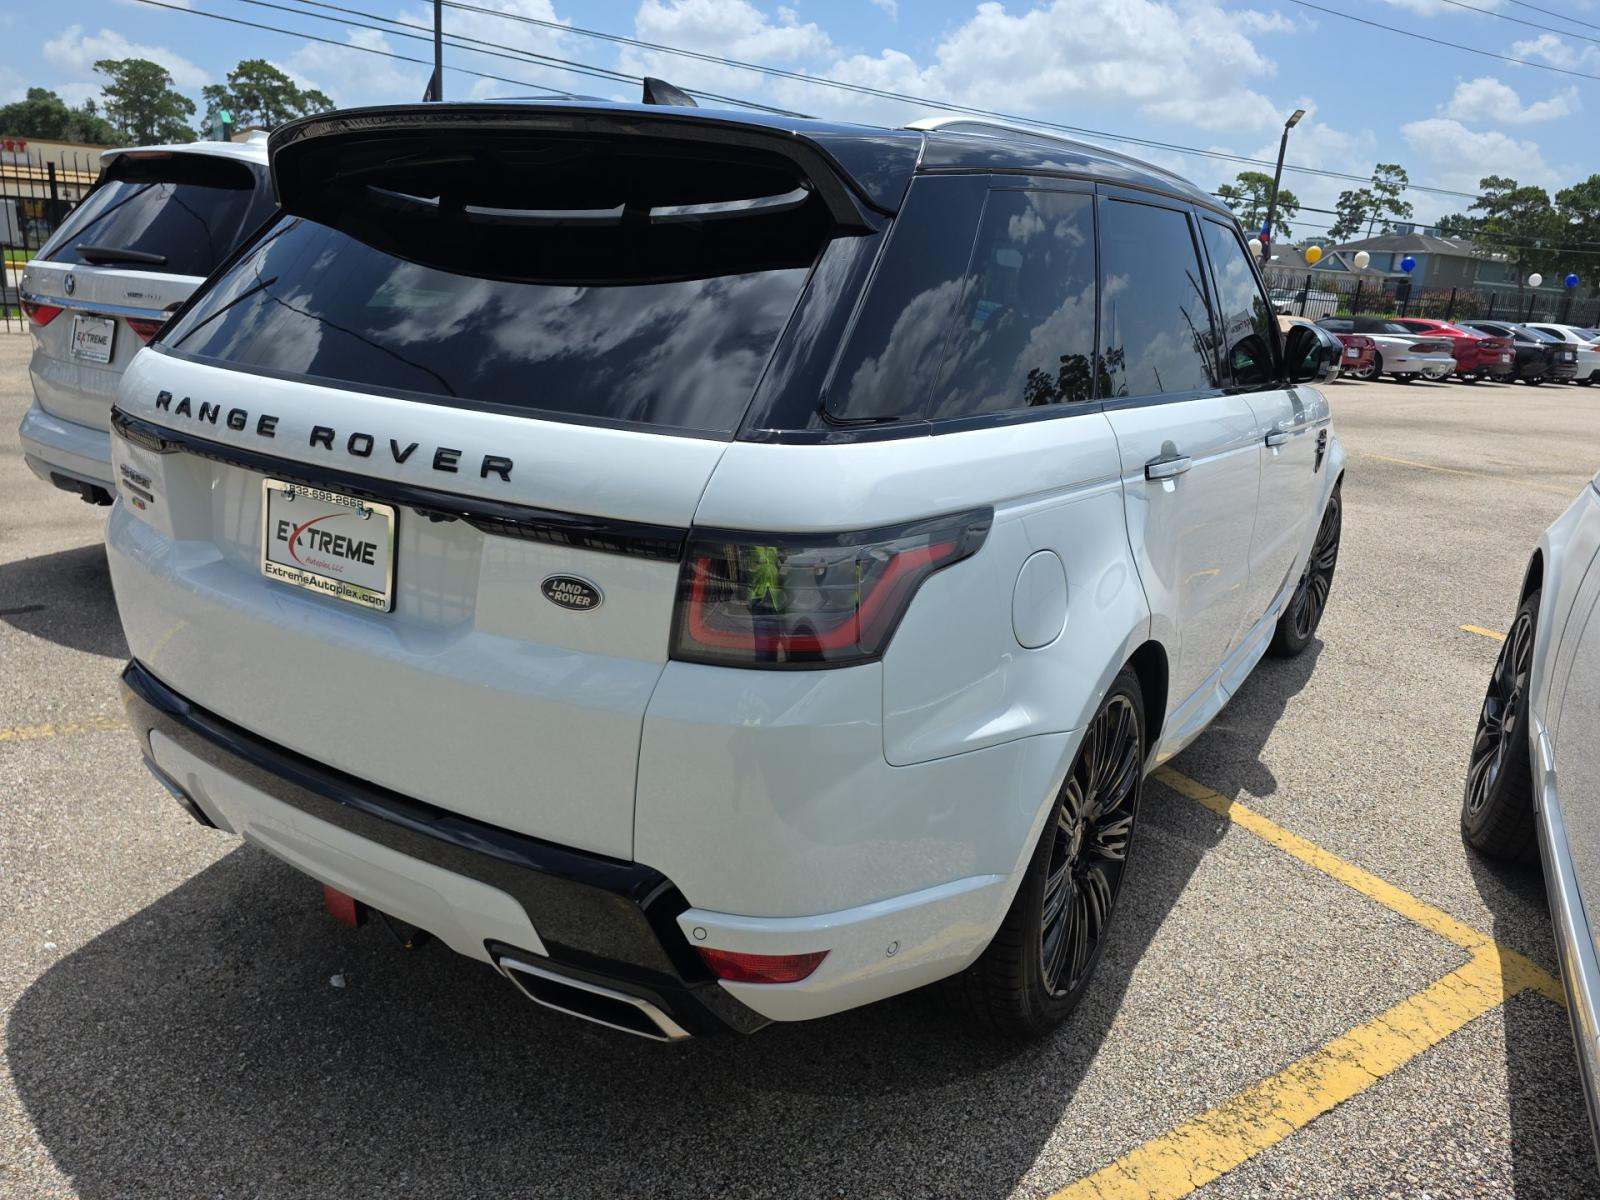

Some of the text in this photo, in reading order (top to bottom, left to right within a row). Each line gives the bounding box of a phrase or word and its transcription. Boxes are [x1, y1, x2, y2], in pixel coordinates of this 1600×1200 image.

[155, 390, 514, 482] RANGE ROVER
[277, 519, 377, 566] EXTREME
[265, 563, 386, 607] ExtremeAutoplex.com
[552, 581, 581, 595] LAND
[554, 591, 591, 606] ROVER
